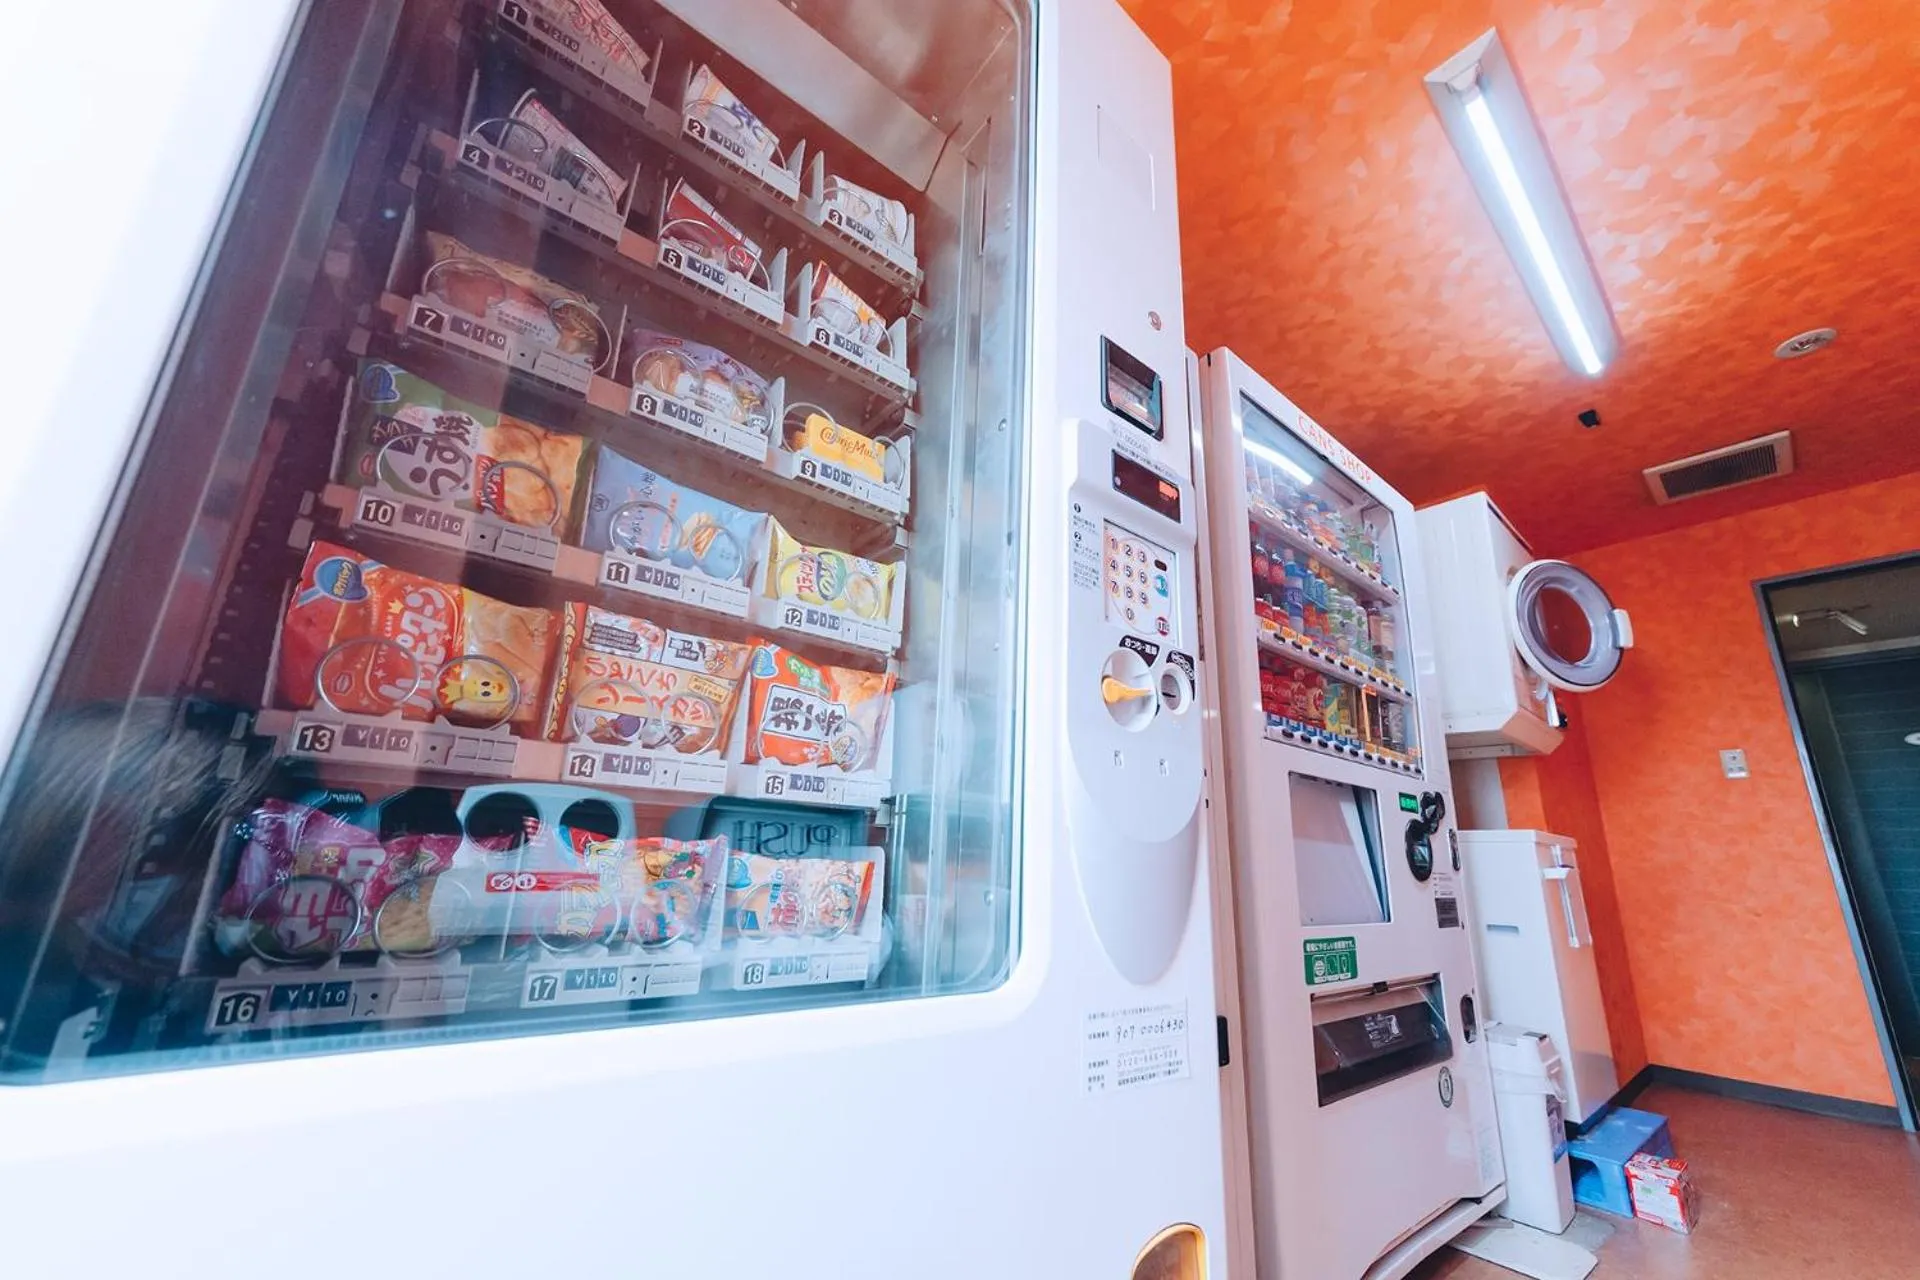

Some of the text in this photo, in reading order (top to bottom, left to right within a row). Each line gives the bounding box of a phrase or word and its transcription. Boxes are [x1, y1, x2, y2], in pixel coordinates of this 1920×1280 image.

[366, 503, 391, 523] 10
[610, 565, 626, 581] 11
[786, 611, 801, 625] 12
[771, 694, 845, 738] 揚一番
[303, 729, 331, 750] 13
[572, 757, 594, 776] 14
[766, 777, 782, 792] 15
[747, 967, 761, 982] 18
[532, 979, 550, 998] 17
[223, 998, 254, 1023] 16
